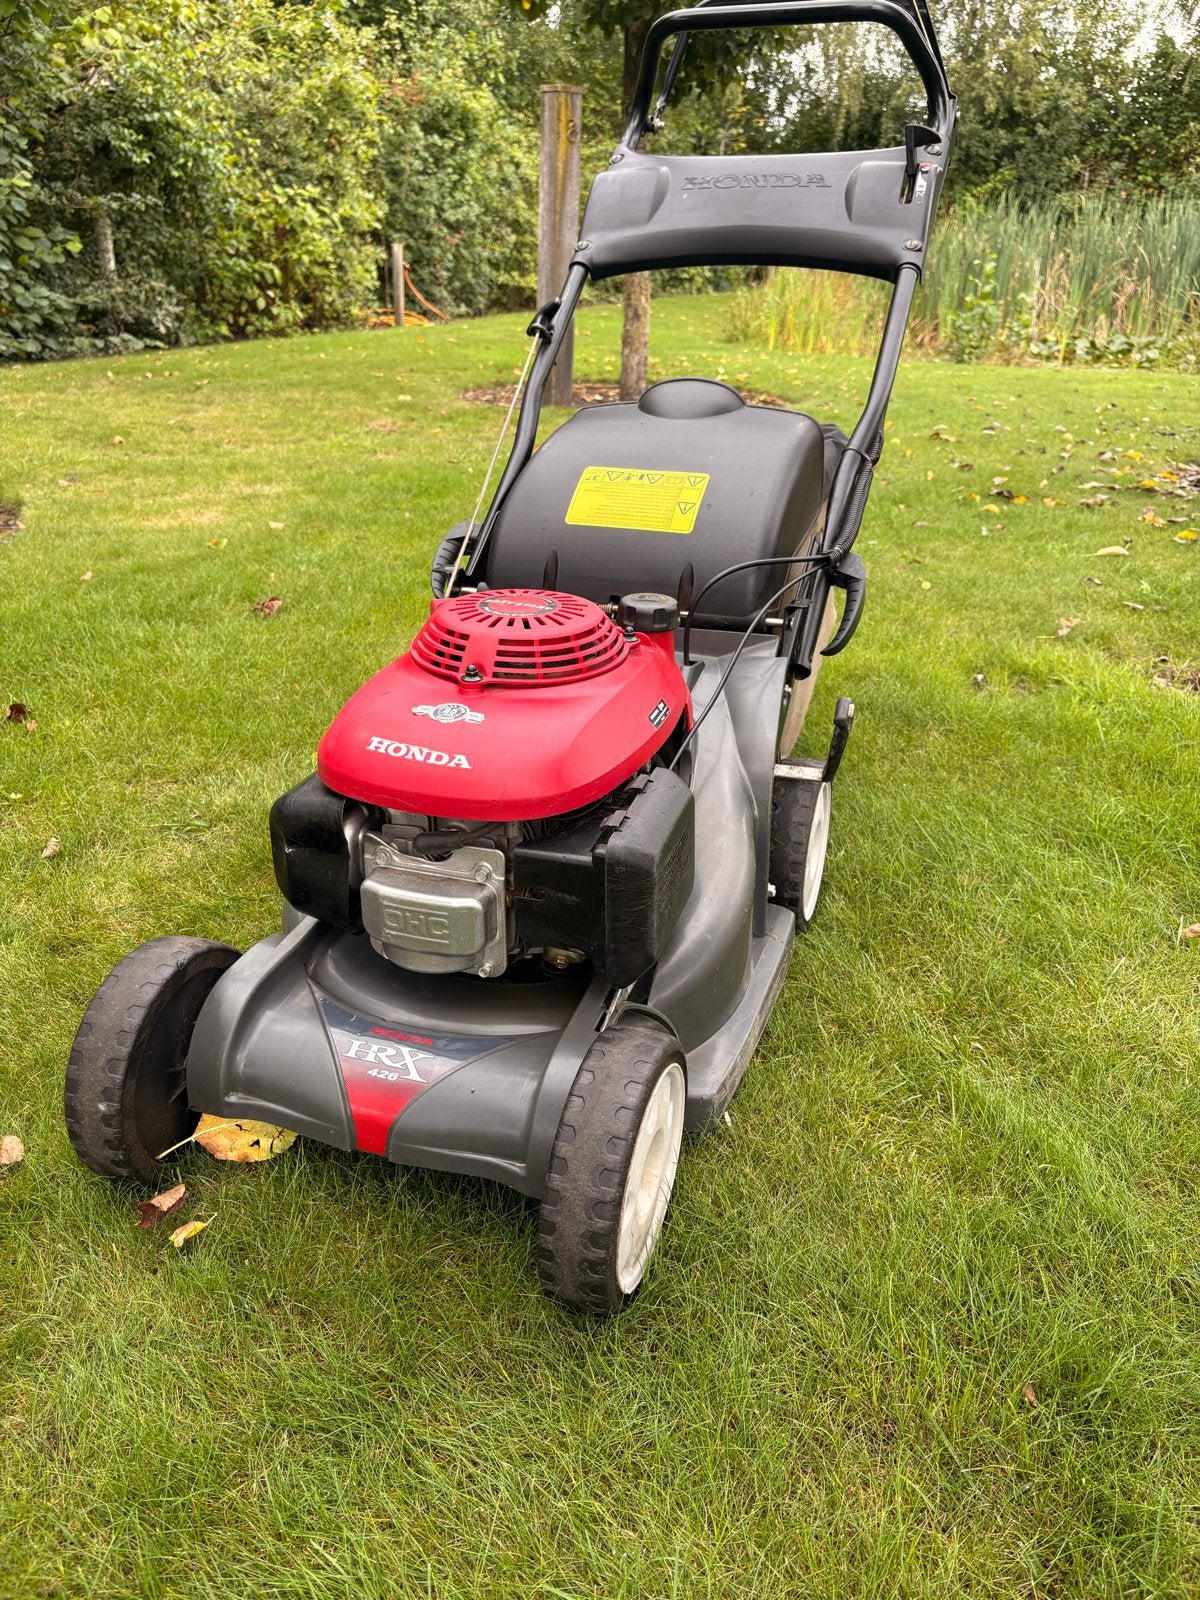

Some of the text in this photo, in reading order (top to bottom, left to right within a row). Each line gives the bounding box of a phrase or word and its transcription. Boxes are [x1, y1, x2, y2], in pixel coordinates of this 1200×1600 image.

[681, 173, 833, 191] HONDA
[366, 736, 472, 770] HONDA
[383, 907, 450, 936] OHC
[369, 1027, 433, 1047] HONDA
[341, 1039, 435, 1084] HRX
[367, 1068, 399, 1081] 426
